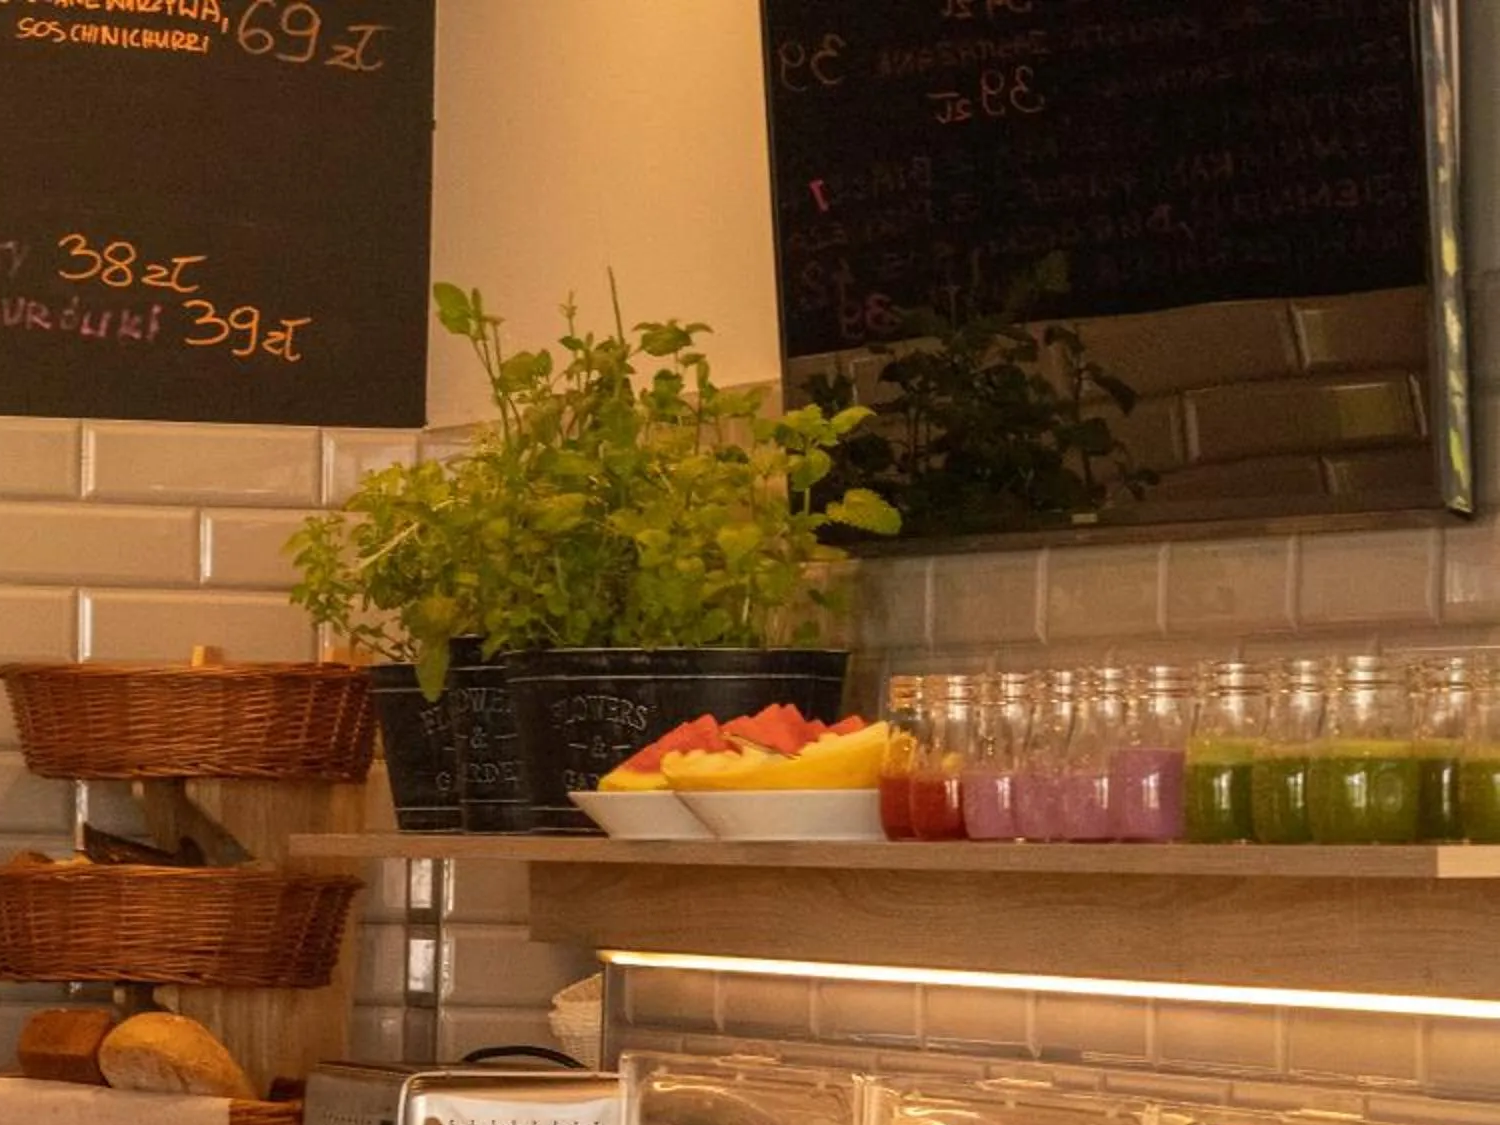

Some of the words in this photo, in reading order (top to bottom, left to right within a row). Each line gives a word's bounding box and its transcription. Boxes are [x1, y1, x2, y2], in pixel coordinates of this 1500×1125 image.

[15, 17, 66, 43] SOS
[237, 0, 322, 63] 69
[57, 233, 137, 288] 38
[183, 301, 261, 356] 39
